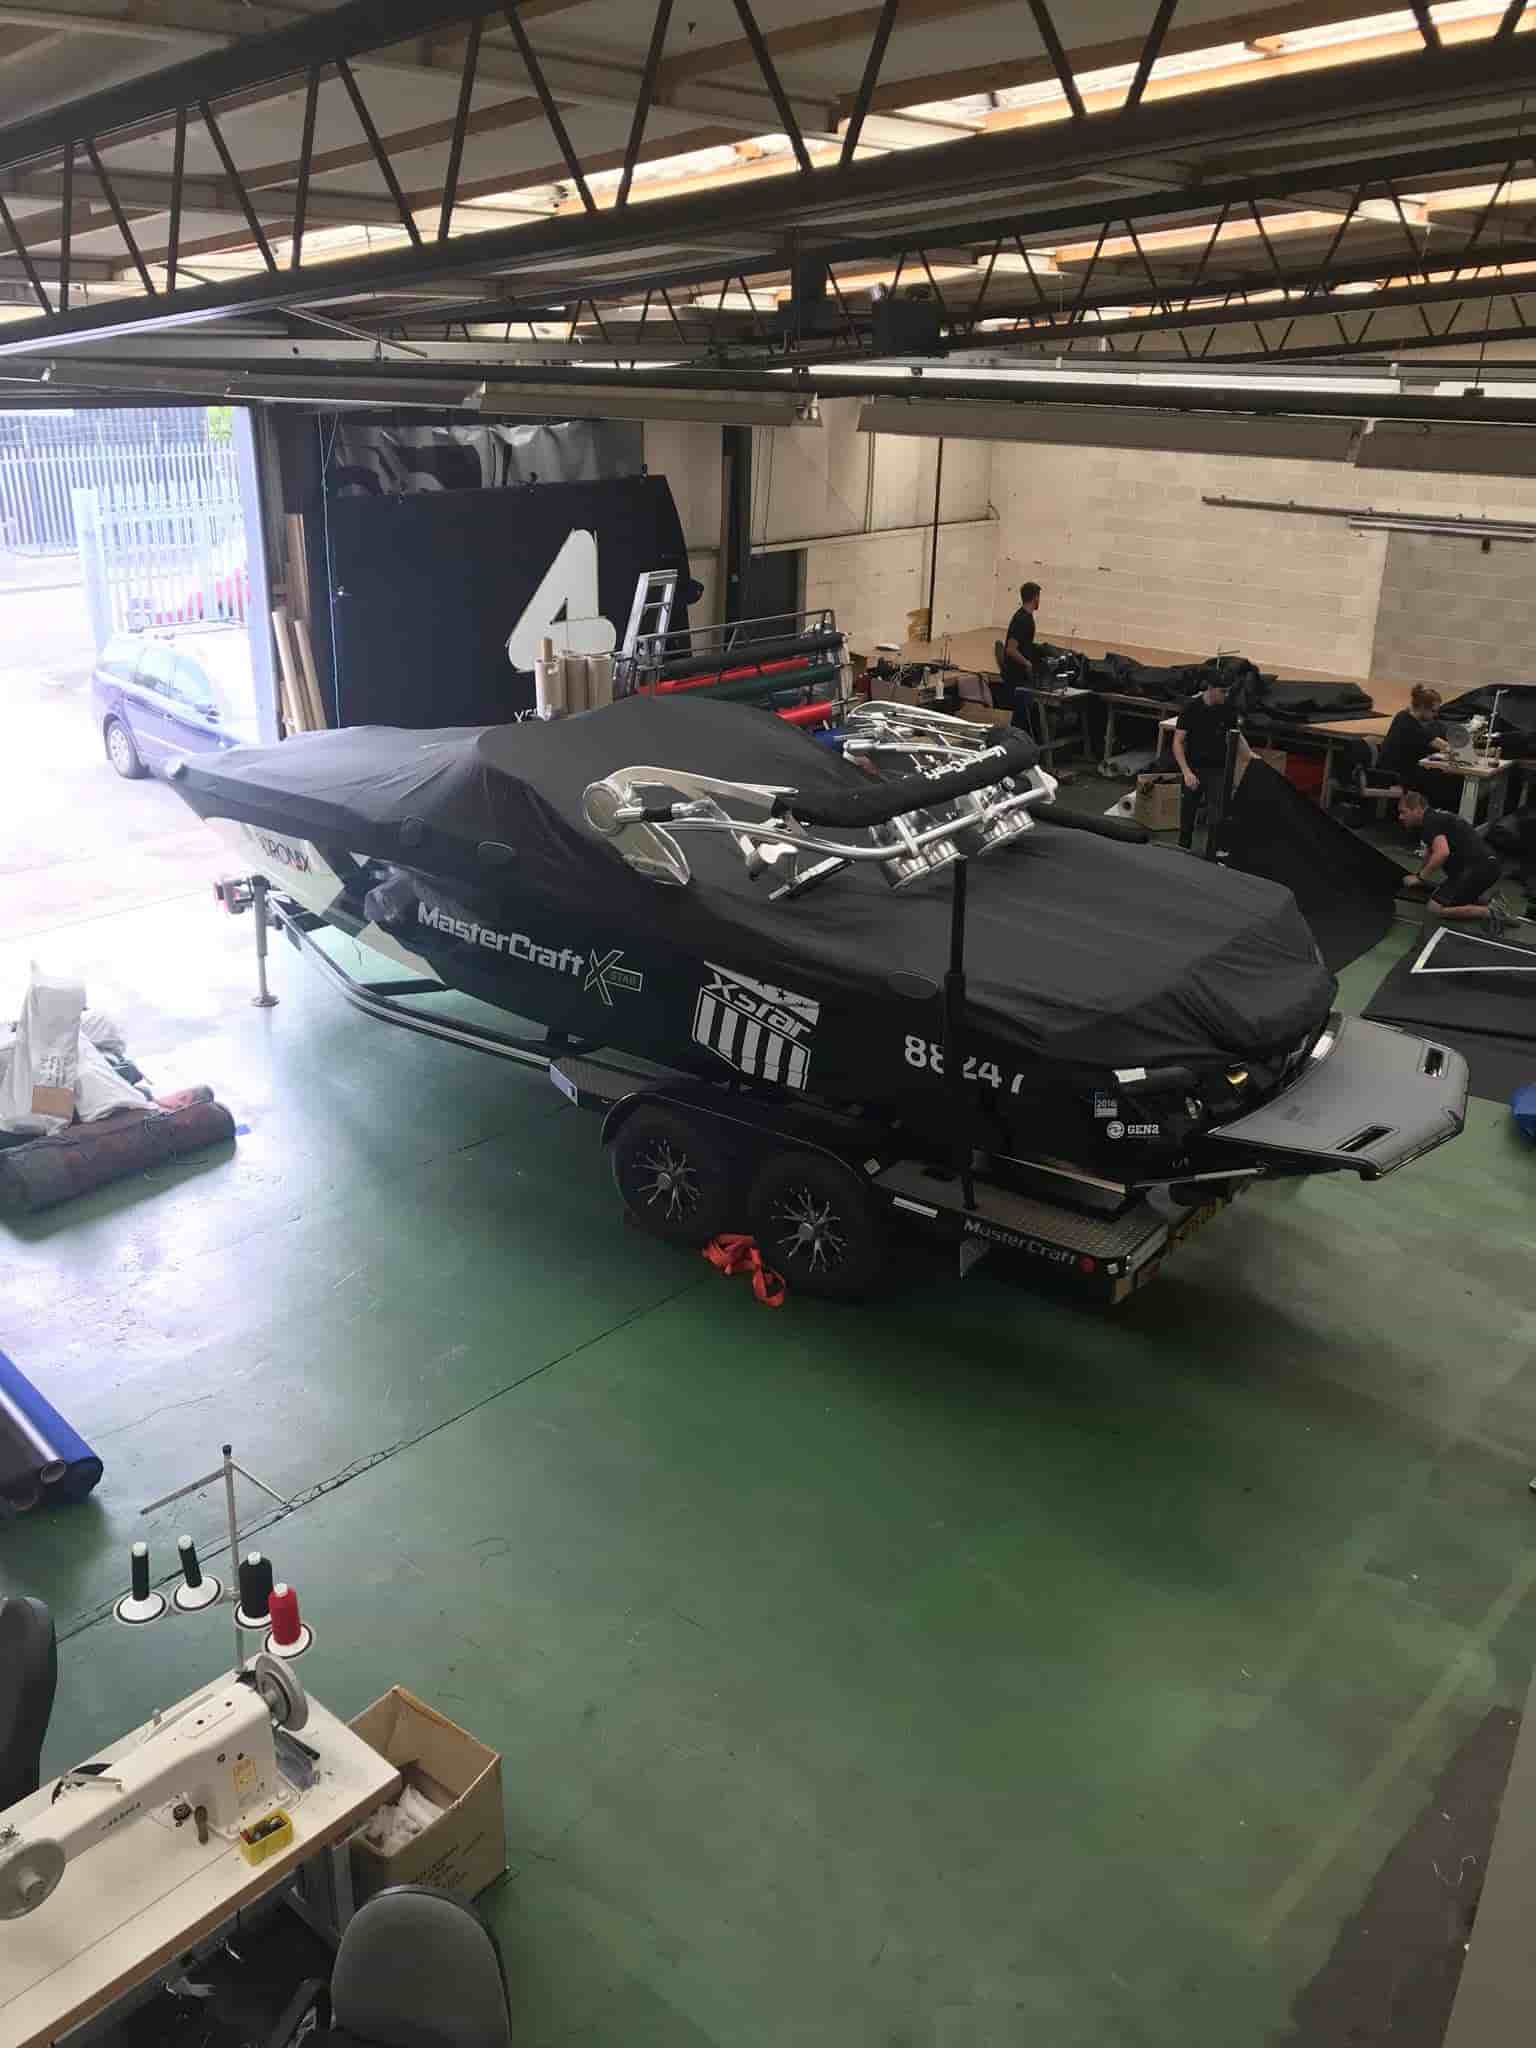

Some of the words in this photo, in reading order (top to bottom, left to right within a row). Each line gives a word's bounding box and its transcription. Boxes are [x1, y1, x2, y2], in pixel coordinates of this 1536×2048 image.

[505, 528, 617, 673] 4
[417, 900, 585, 977] MasterCraft
[1127, 1123, 1159, 1135] GEN2
